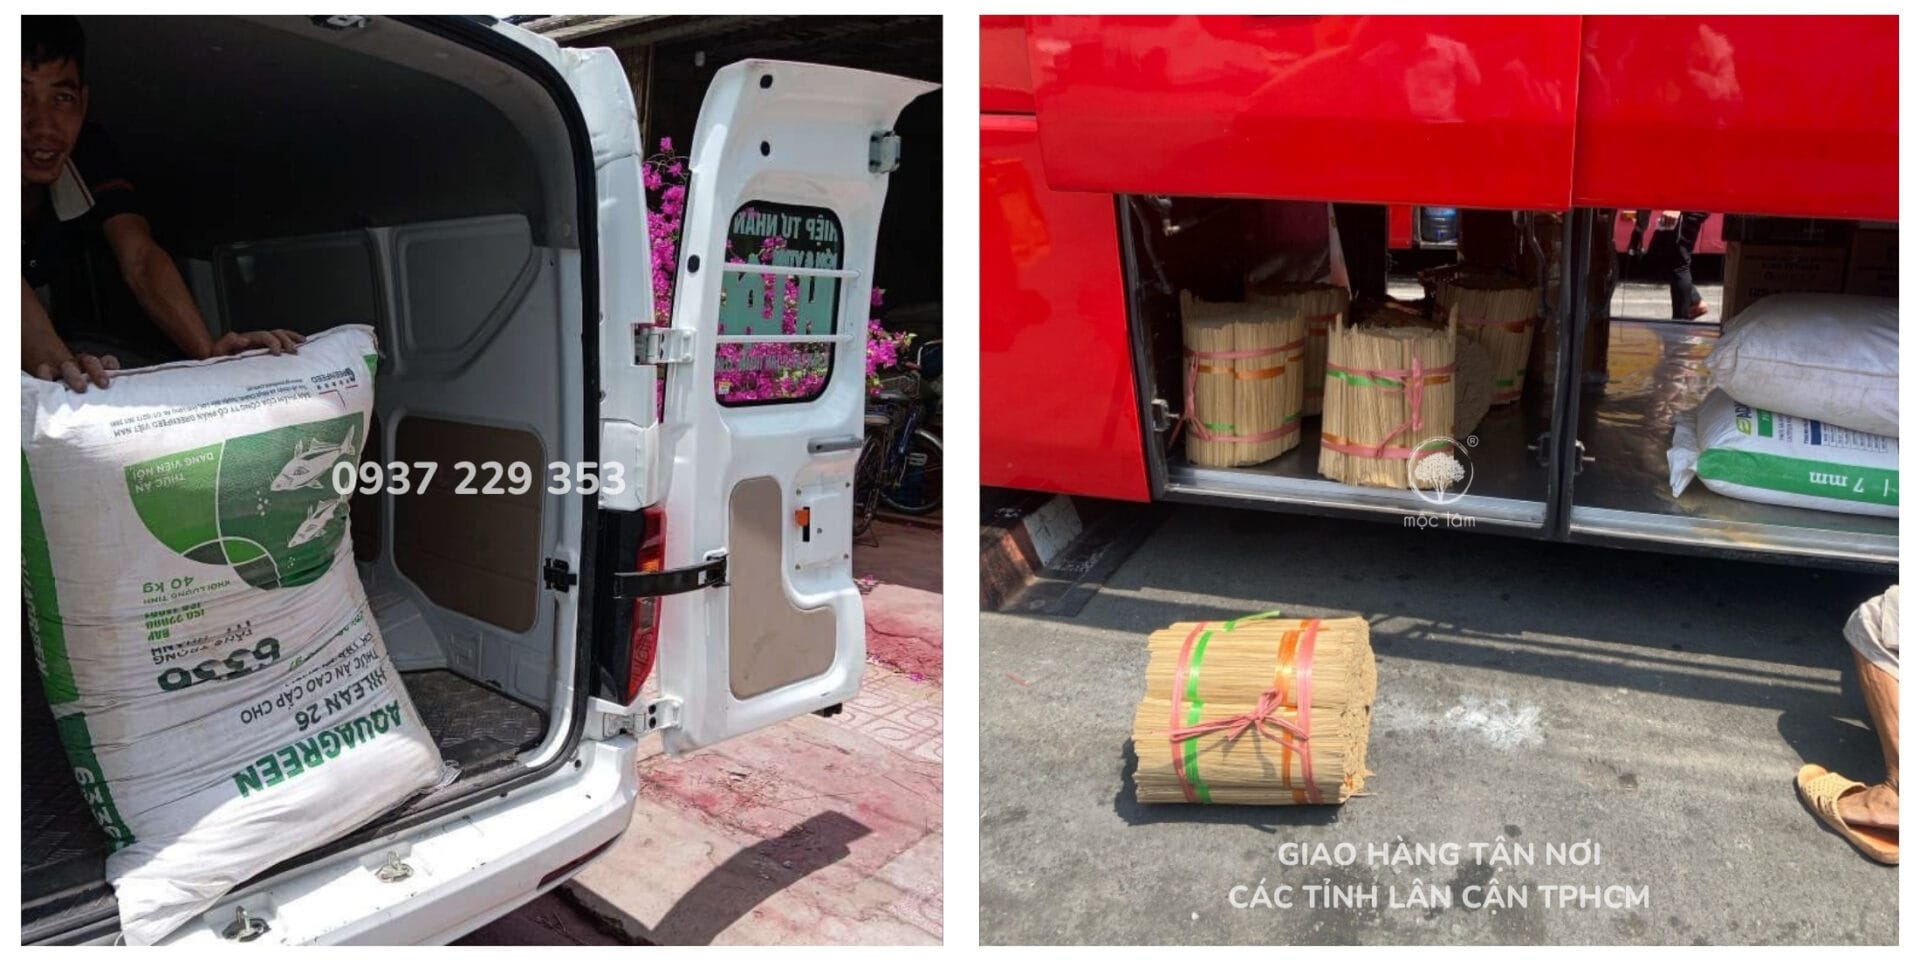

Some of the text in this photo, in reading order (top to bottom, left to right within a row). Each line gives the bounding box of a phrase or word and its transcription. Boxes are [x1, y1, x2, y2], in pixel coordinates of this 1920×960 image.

[1809, 471, 1865, 493] 7 mm
[143, 576, 194, 594] 40 kg
[306, 671, 333, 693] CAO
[323, 666, 388, 716] HILEAN
[276, 686, 304, 710] CẤP
[240, 700, 273, 725] CHO
[295, 703, 322, 731] 26
[232, 699, 402, 798] AQUAGREEN
